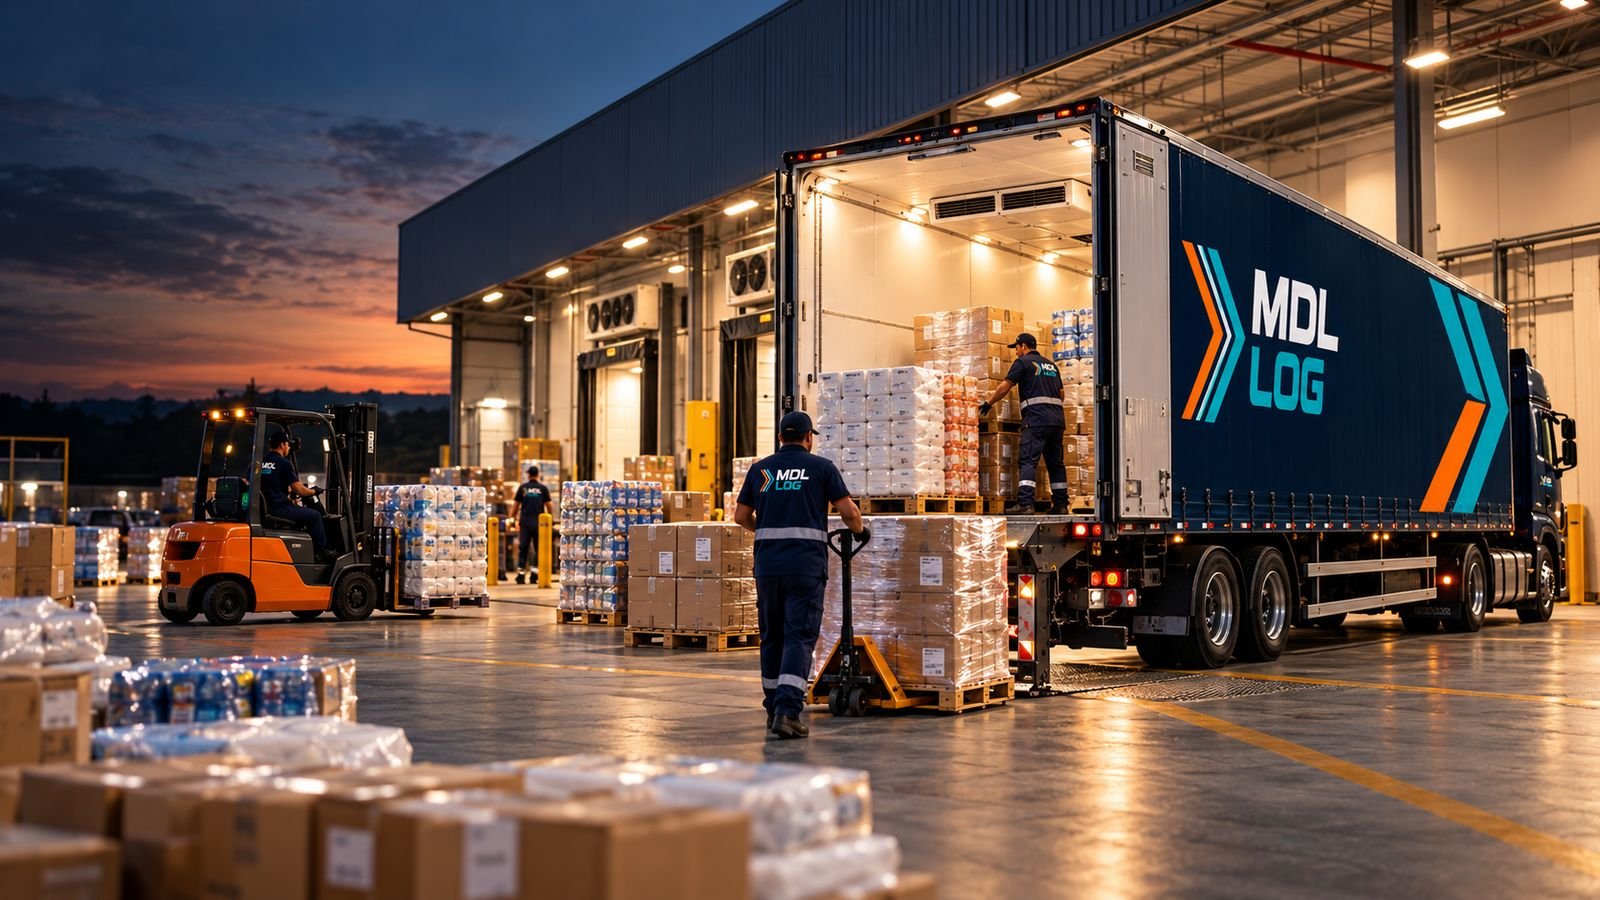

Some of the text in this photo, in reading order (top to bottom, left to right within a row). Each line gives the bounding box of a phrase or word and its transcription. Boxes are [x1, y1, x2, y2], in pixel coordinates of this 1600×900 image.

[1252, 268, 1339, 352] MDL
[1250, 346, 1324, 415] LOG
[775, 481, 802, 490] LOG
[776, 469, 809, 480] MDL
